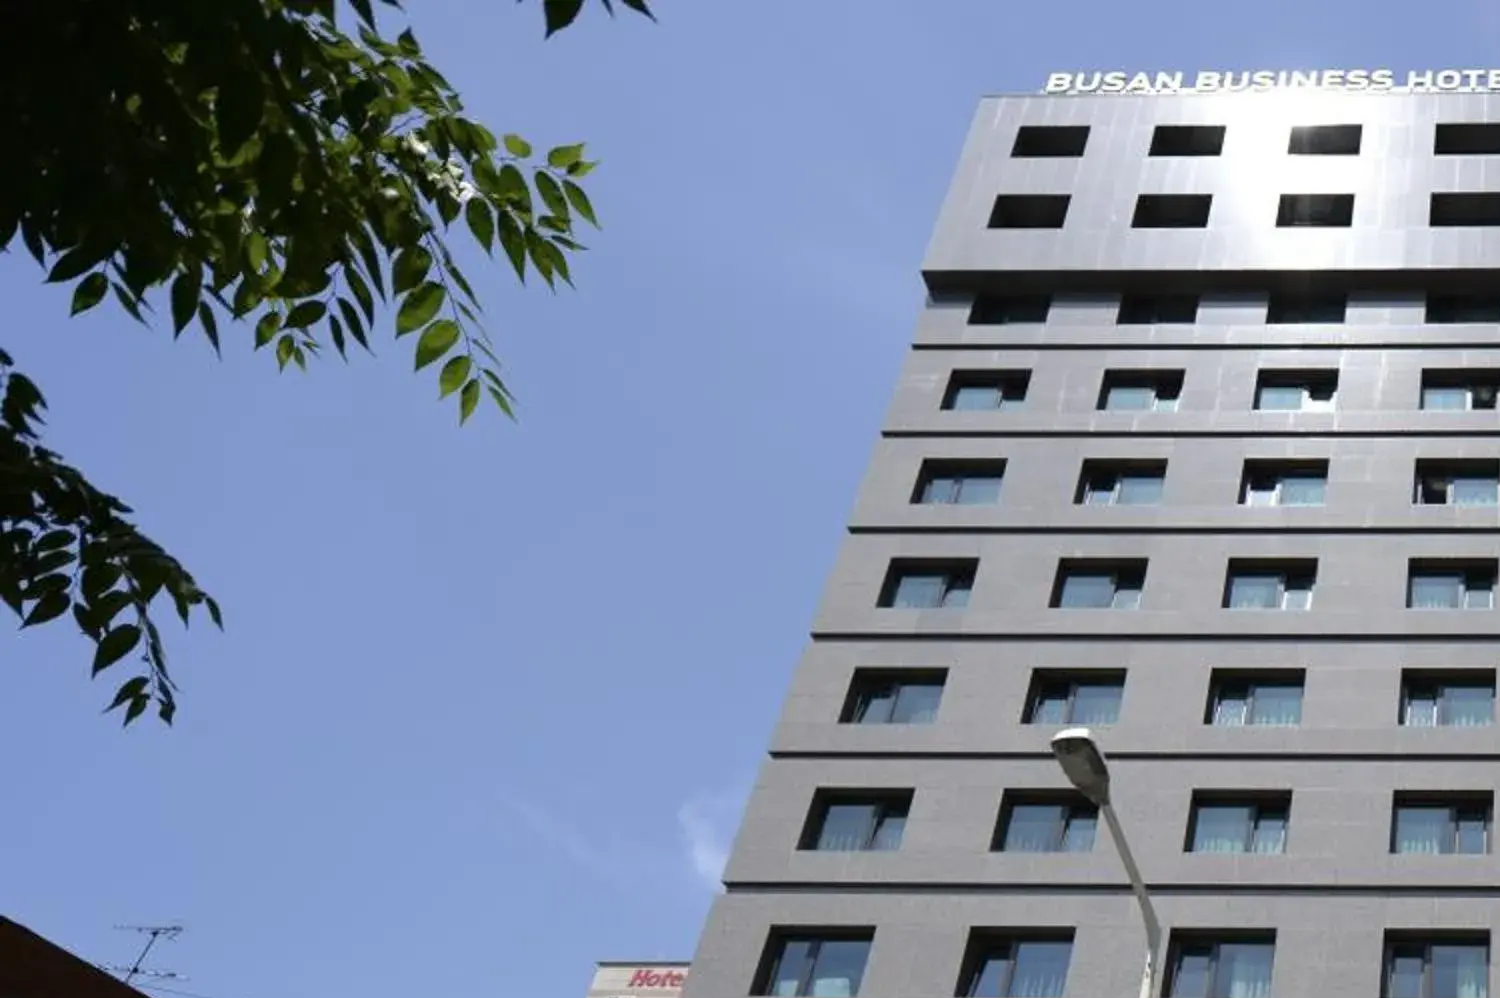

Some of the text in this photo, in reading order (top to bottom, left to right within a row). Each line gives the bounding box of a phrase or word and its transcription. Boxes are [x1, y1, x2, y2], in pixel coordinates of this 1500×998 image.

[1045, 71, 1183, 94] BUSAN
[1195, 69, 1394, 93] BUSINESS
[626, 969, 686, 988] Hote
